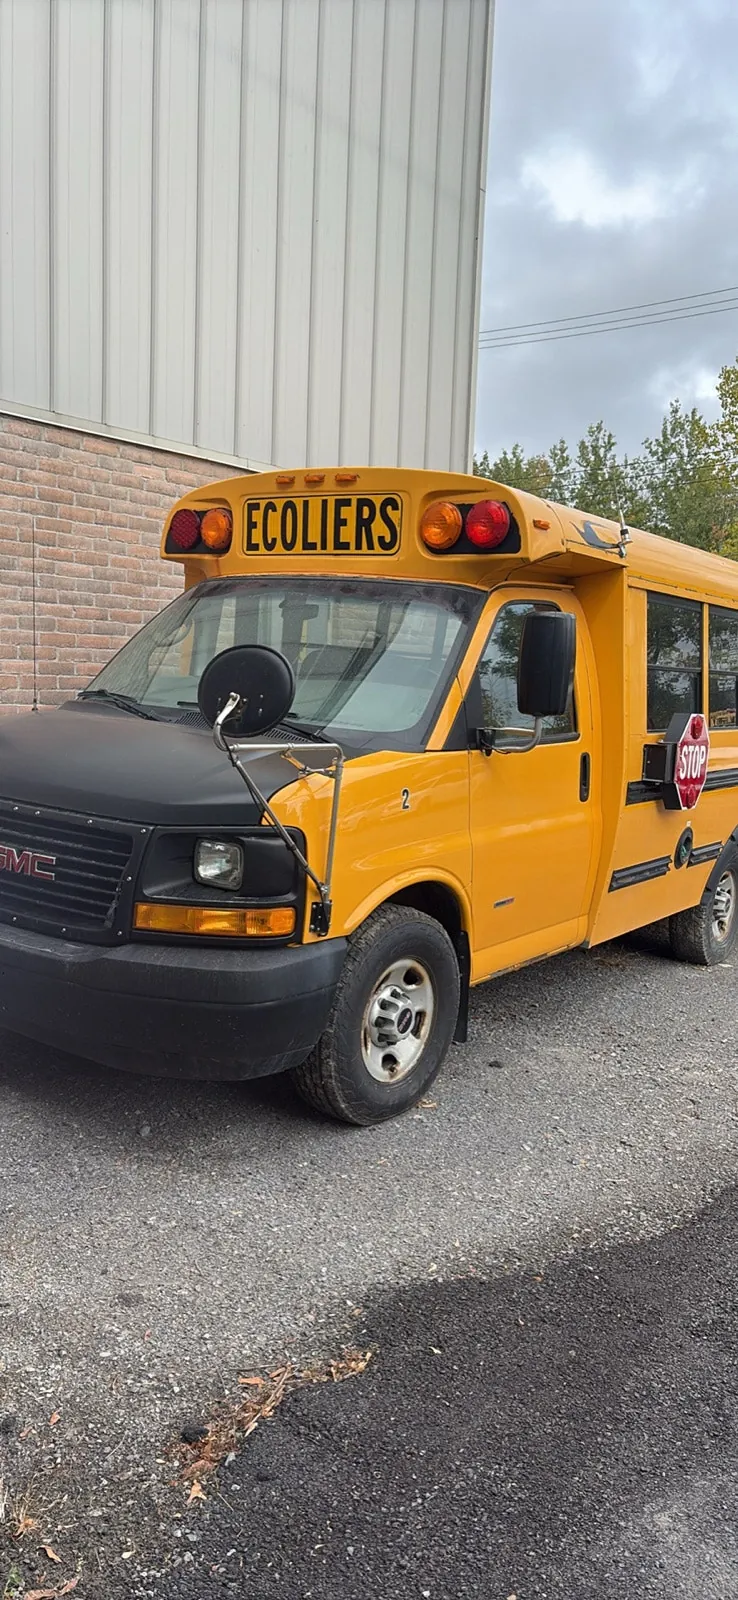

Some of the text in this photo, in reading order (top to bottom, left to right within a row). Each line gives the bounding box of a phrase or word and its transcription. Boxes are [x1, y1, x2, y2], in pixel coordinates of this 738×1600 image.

[246, 497, 399, 552] ECOLIERS
[679, 745, 706, 780] STOP
[401, 788, 410, 809] 2
